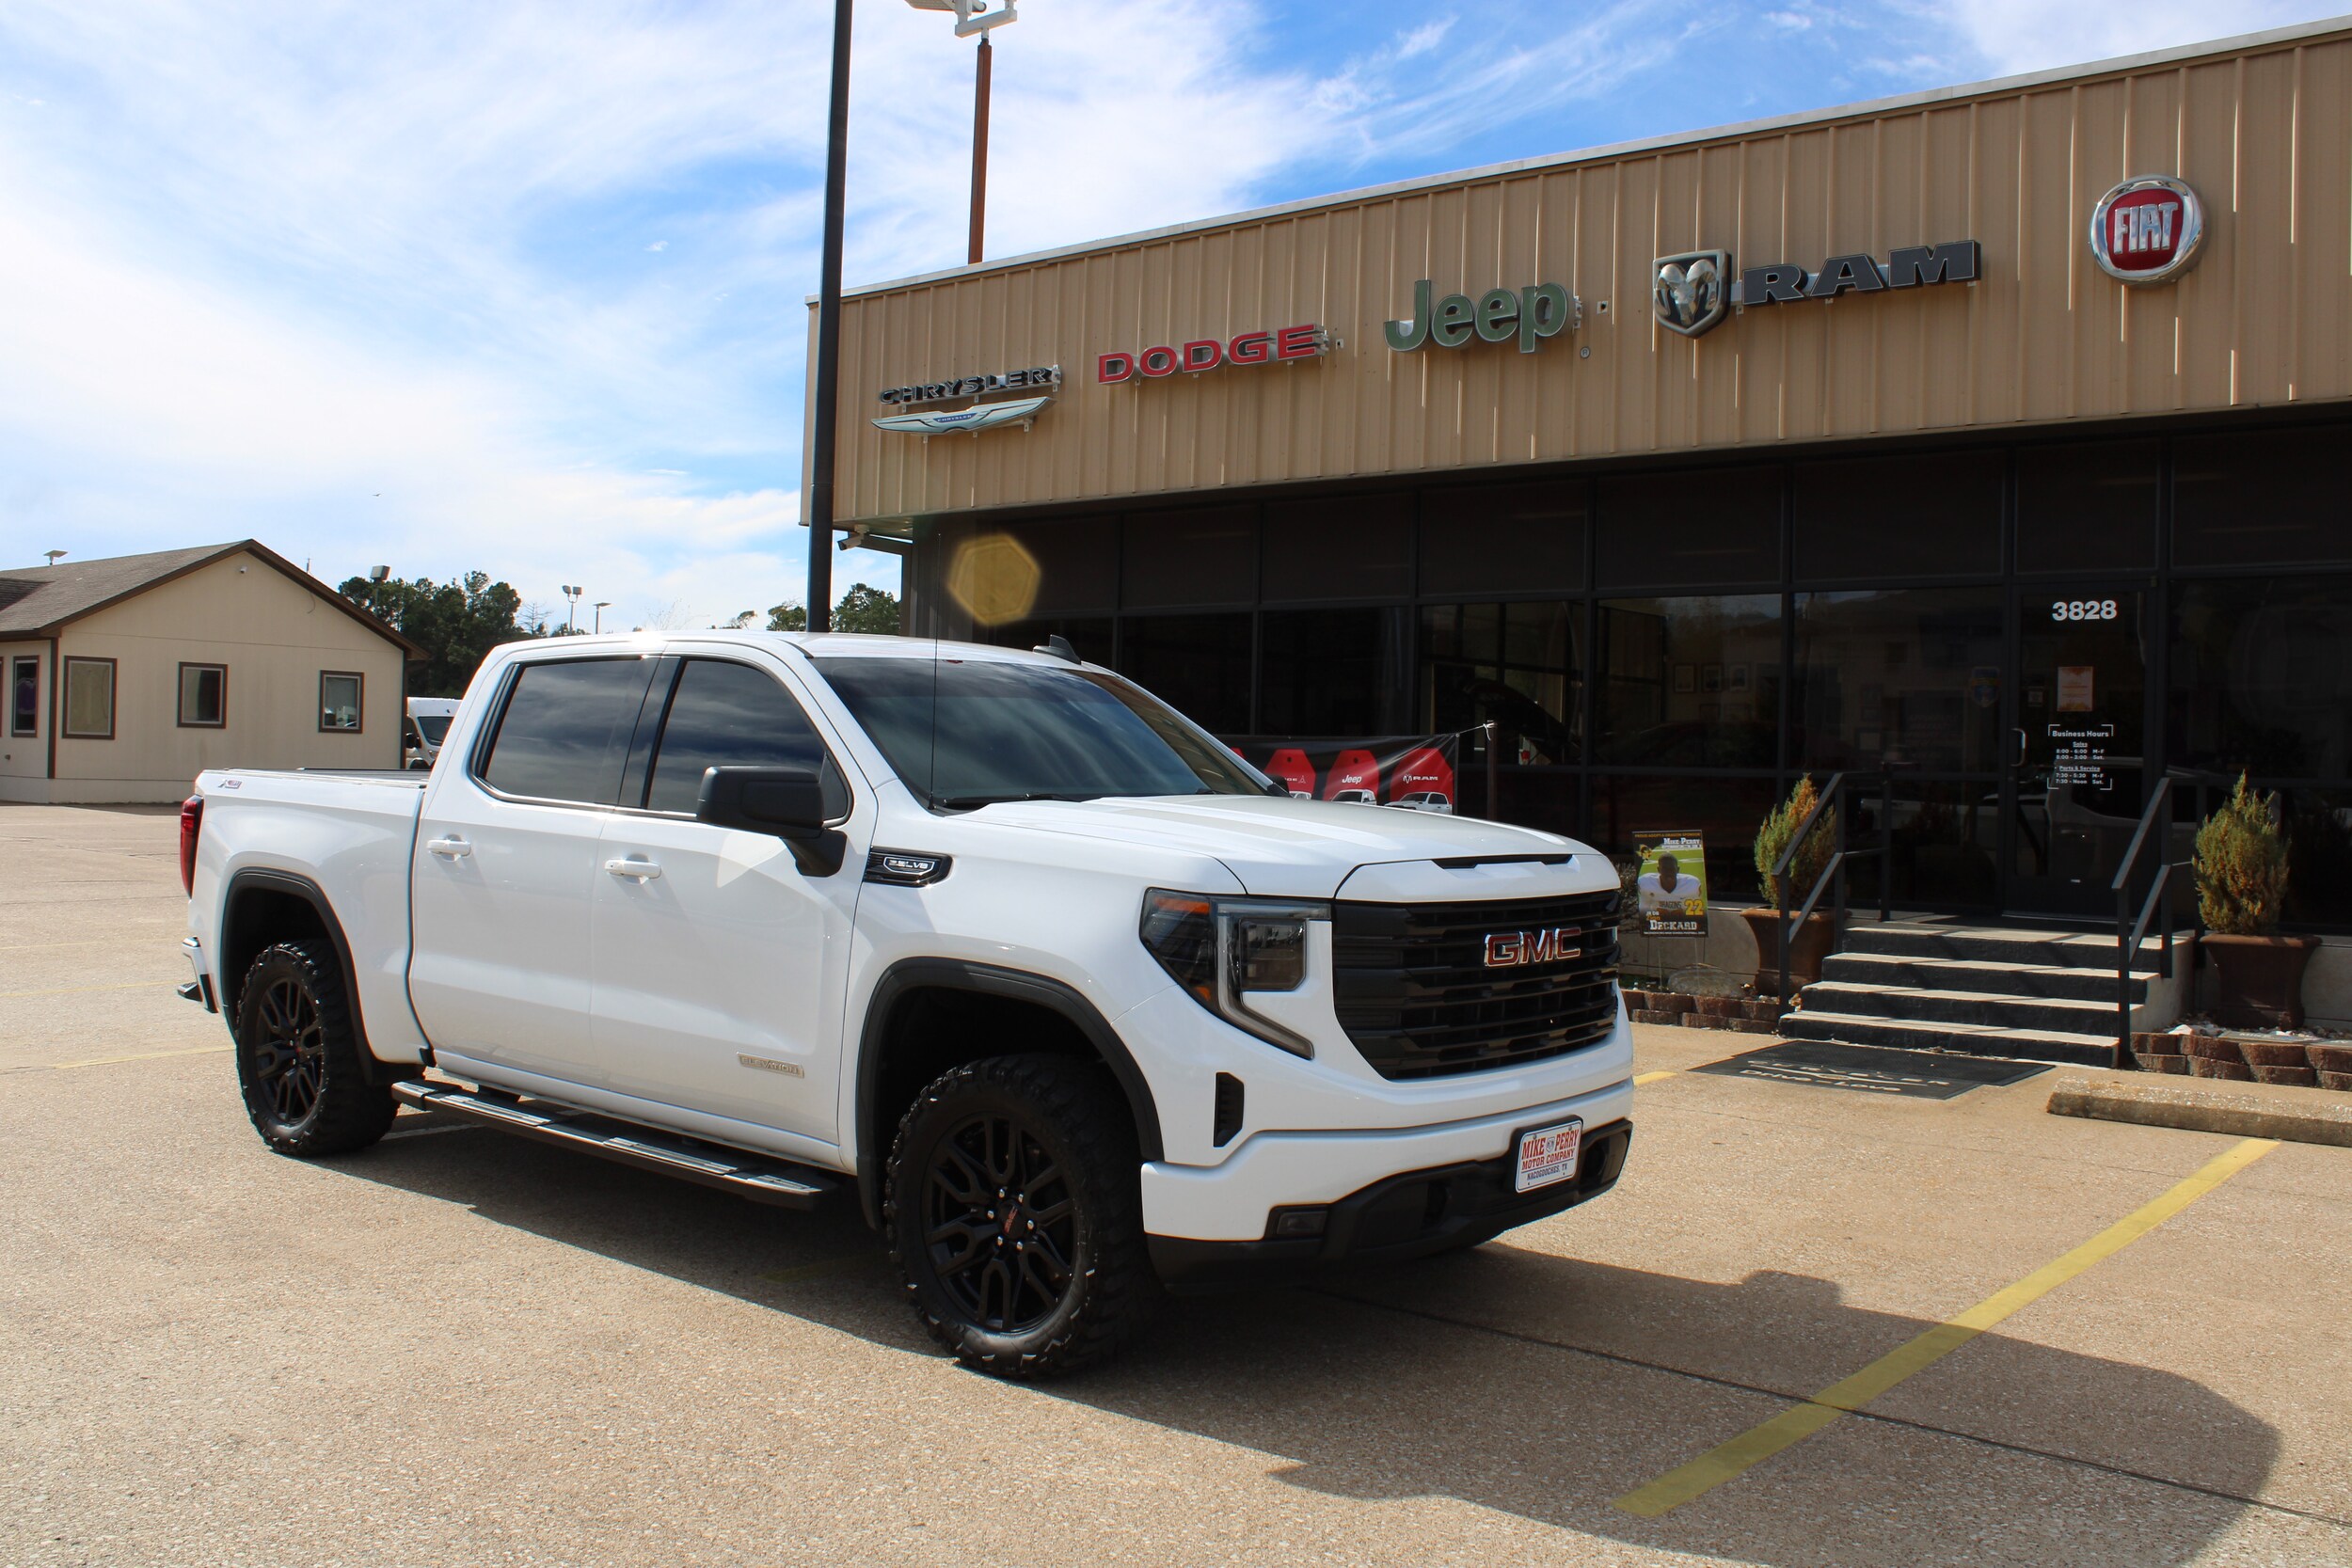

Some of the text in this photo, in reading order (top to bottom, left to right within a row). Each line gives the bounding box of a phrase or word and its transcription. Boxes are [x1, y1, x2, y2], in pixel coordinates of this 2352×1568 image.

[2113, 200, 2180, 254] FIAT
[1741, 239, 1981, 307] RAM
[1383, 279, 1569, 354] Jeep
[1098, 323, 1321, 385] DODGE
[878, 366, 1051, 405] CHRYSLER
[937, 414, 972, 422] CHRYSLER
[2052, 599, 2117, 621] 3828
[1342, 774, 1362, 785] Jeep
[1684, 899, 1704, 916] 22
[1650, 920, 1697, 930] DECKARD
[1484, 927, 1581, 967] GMC
[1521, 1129, 1580, 1160] MIKE PERRY
[1521, 1148, 1575, 1170] MOTOR COMPANY
